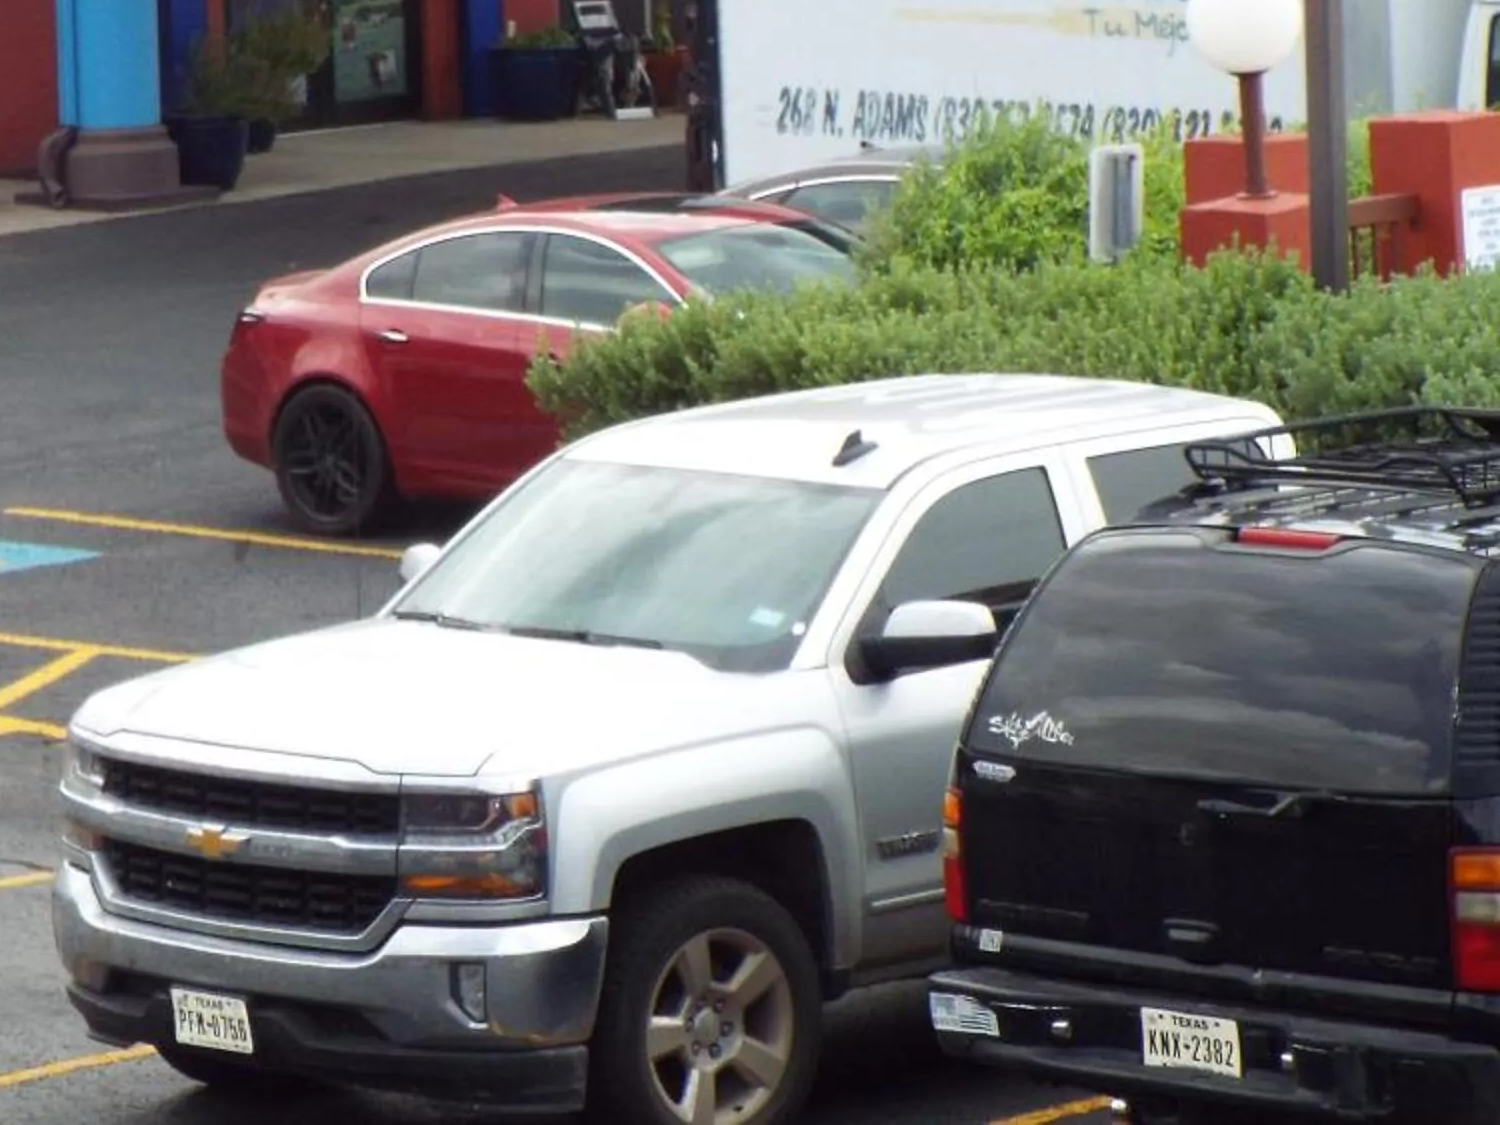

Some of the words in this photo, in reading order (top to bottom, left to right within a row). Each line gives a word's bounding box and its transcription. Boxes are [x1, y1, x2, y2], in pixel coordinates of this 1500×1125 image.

[1082, 9, 1126, 39] Tu
[1134, 11, 1192, 57] Mejo
[823, 87, 843, 137] N.
[853, 89, 928, 142] ADAMS
[1172, 1015, 1209, 1030] TEXAS
[1149, 1028, 1234, 1068] KNX-2382
